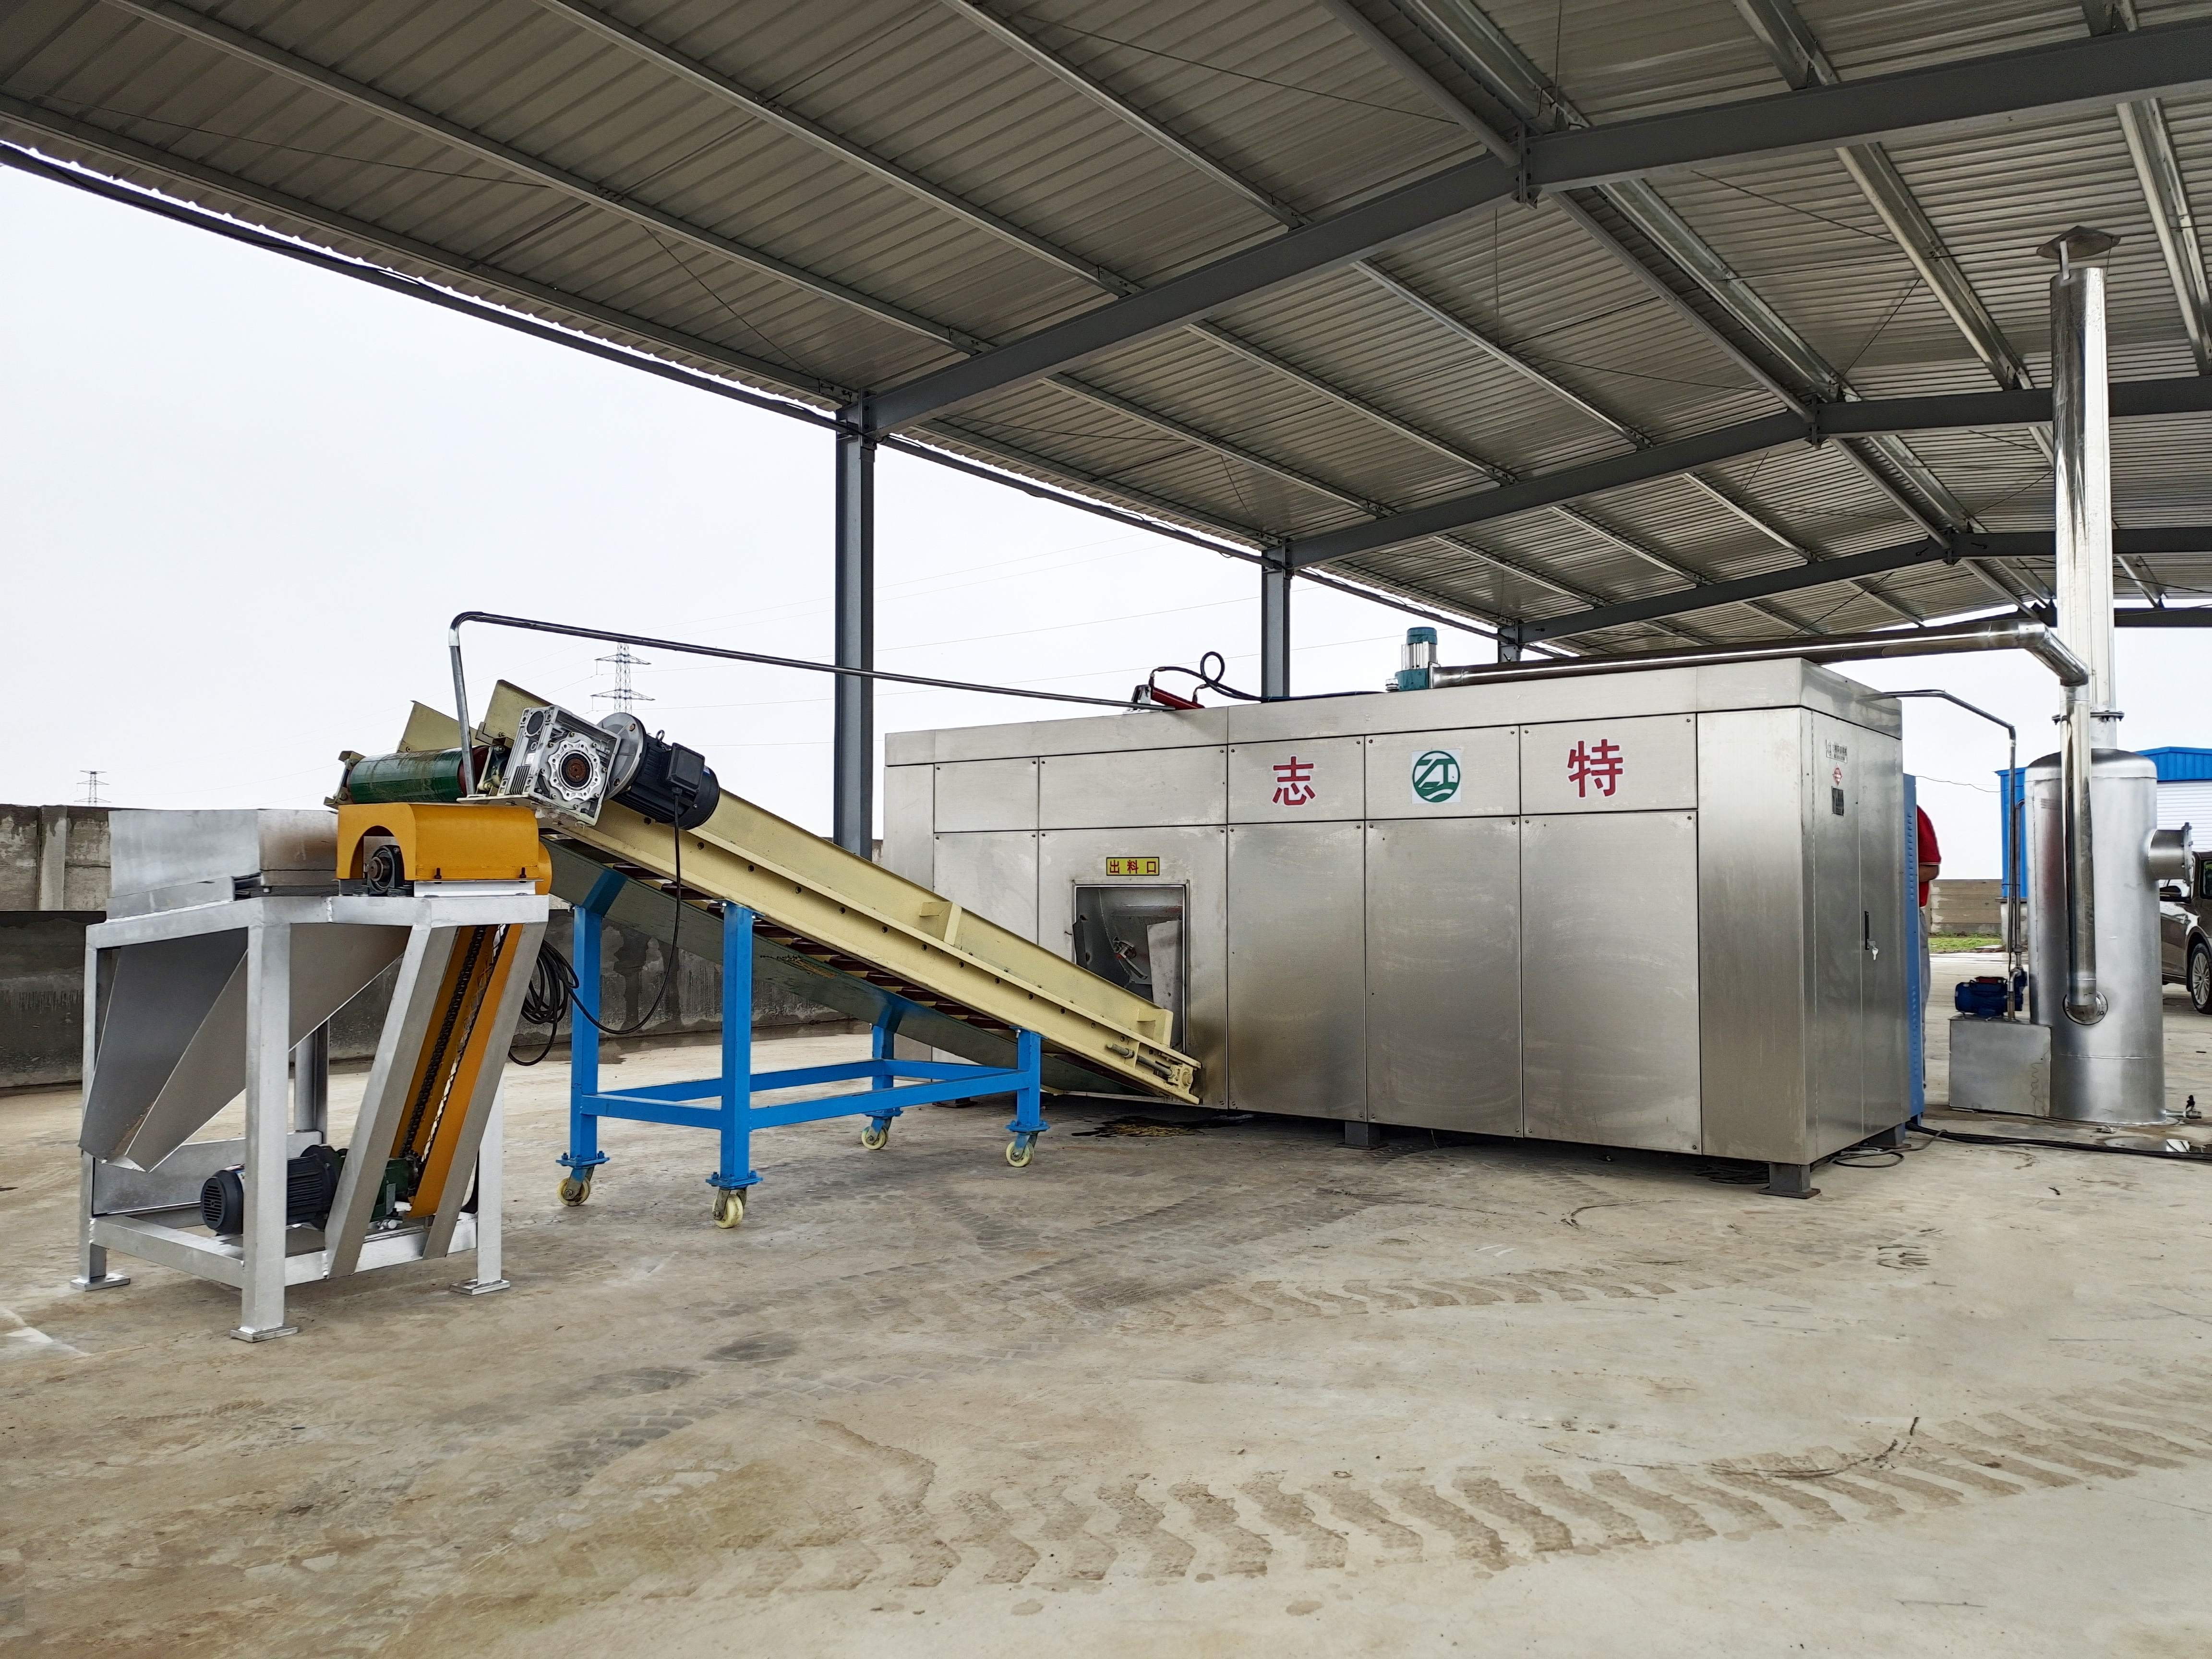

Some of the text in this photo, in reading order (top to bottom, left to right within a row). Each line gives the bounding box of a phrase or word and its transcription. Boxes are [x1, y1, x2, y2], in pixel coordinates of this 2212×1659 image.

[1273, 756, 1316, 806] 志
[1567, 739, 1623, 798] 特
[1109, 859, 1156, 874] 出料口
